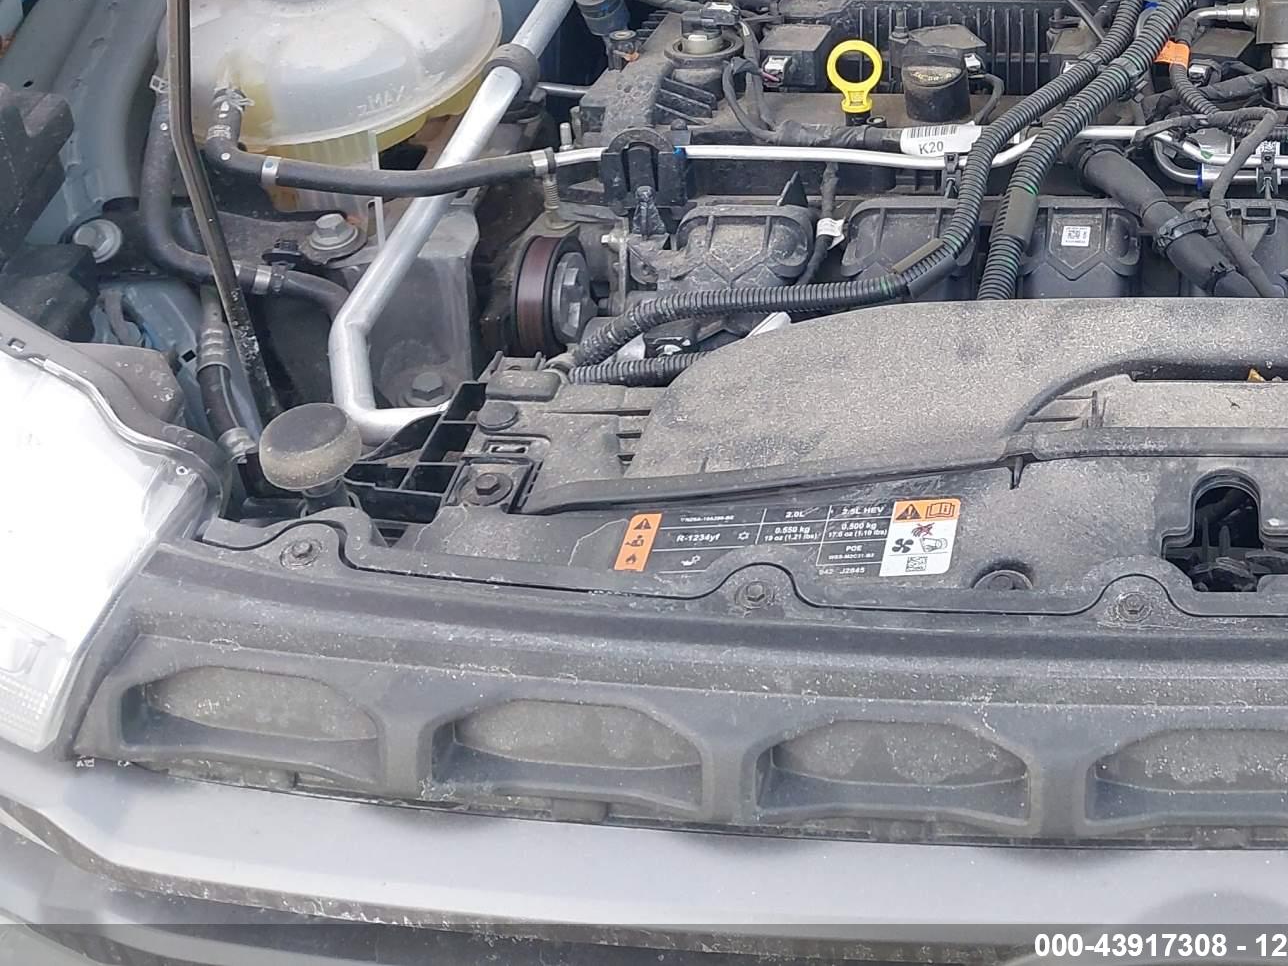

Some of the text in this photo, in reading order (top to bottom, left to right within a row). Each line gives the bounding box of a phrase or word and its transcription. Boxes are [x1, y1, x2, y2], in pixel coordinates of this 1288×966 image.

[919, 141, 944, 155] K20
[863, 506, 885, 514] HEV
[799, 526, 811, 534] kg
[865, 522, 878, 530] kg
[676, 533, 721, 543] R-1234yf
